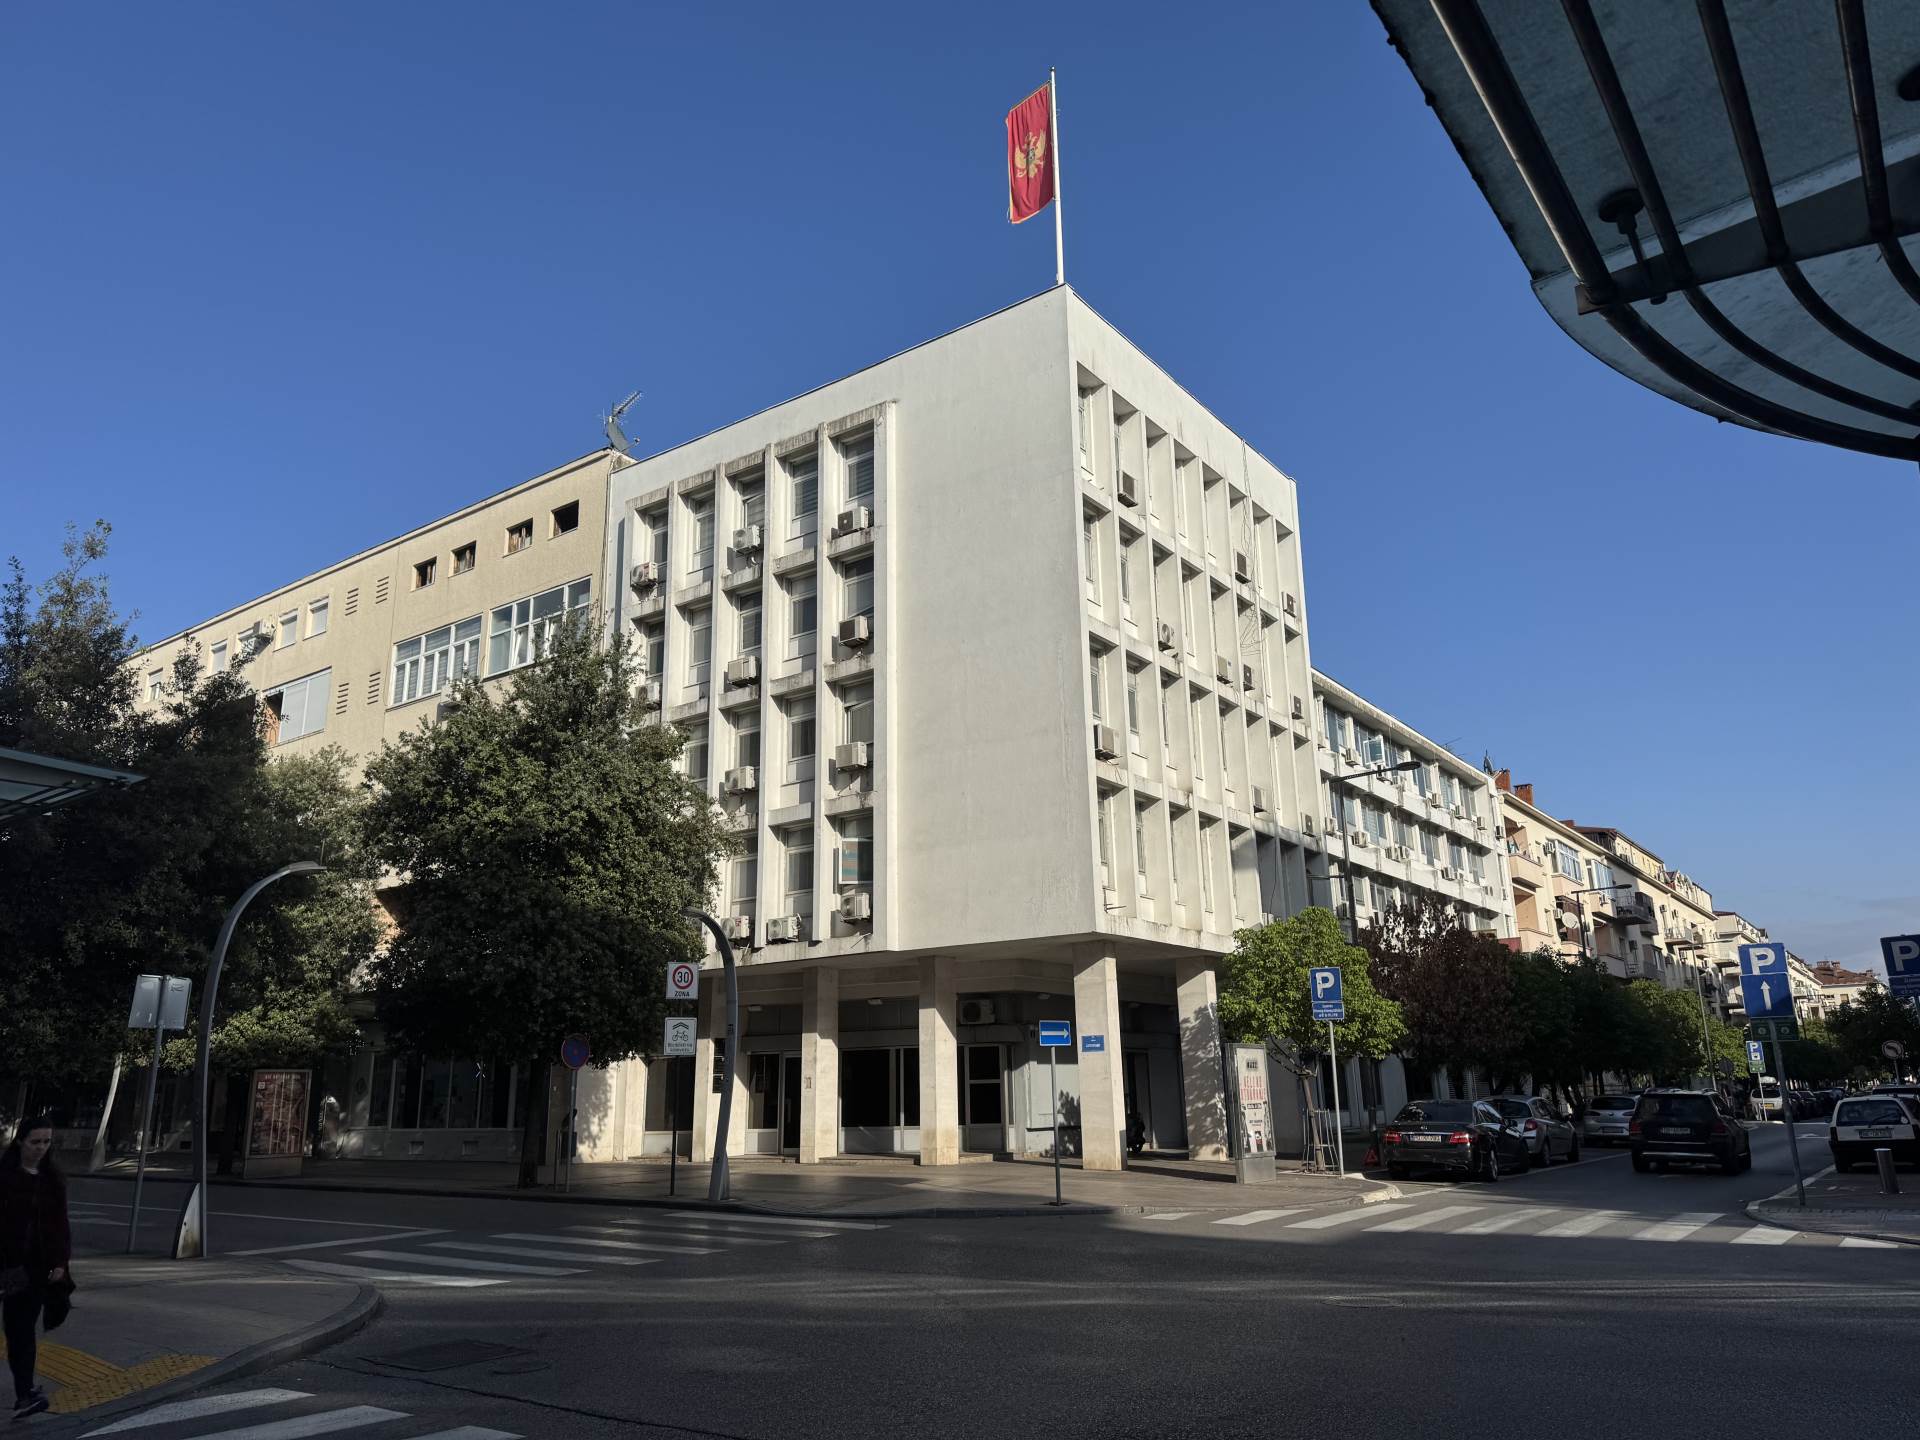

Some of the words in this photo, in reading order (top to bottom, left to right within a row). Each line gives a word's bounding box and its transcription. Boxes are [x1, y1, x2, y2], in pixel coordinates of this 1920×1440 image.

[1749, 947, 1776, 975] P
[1890, 940, 1920, 971] P
[677, 971, 690, 983] 30
[1315, 971, 1335, 999] P
[1749, 1042, 1759, 1053] P
